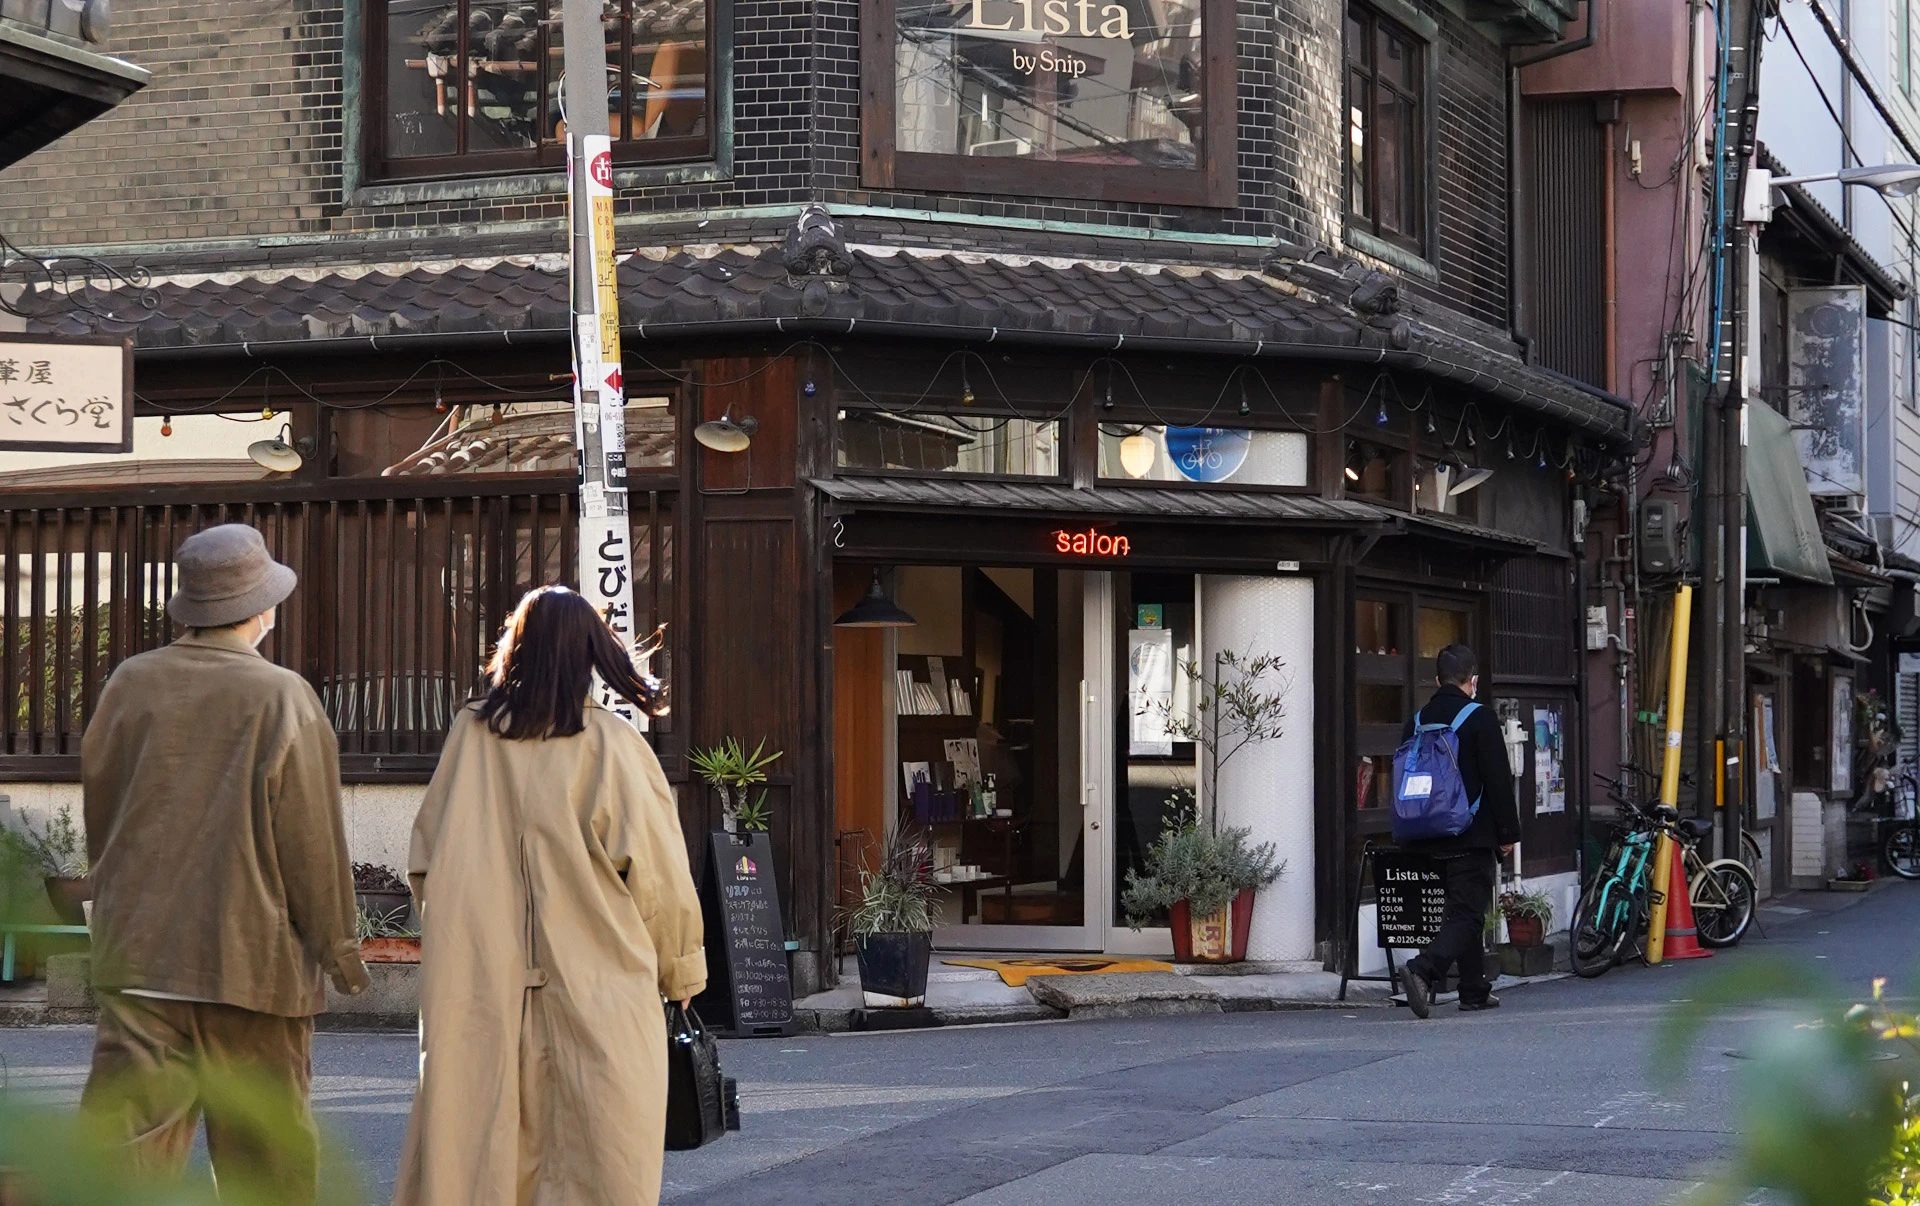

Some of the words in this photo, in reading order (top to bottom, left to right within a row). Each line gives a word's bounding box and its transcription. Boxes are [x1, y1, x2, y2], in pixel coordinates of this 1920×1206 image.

[965, 0, 1135, 40] Lista
[1012, 48, 1037, 75] by
[1040, 50, 1086, 79] Snip
[2, 395, 115, 428] さくら堂
[1055, 528, 1131, 556] salon
[1386, 869, 1419, 881] Lista
